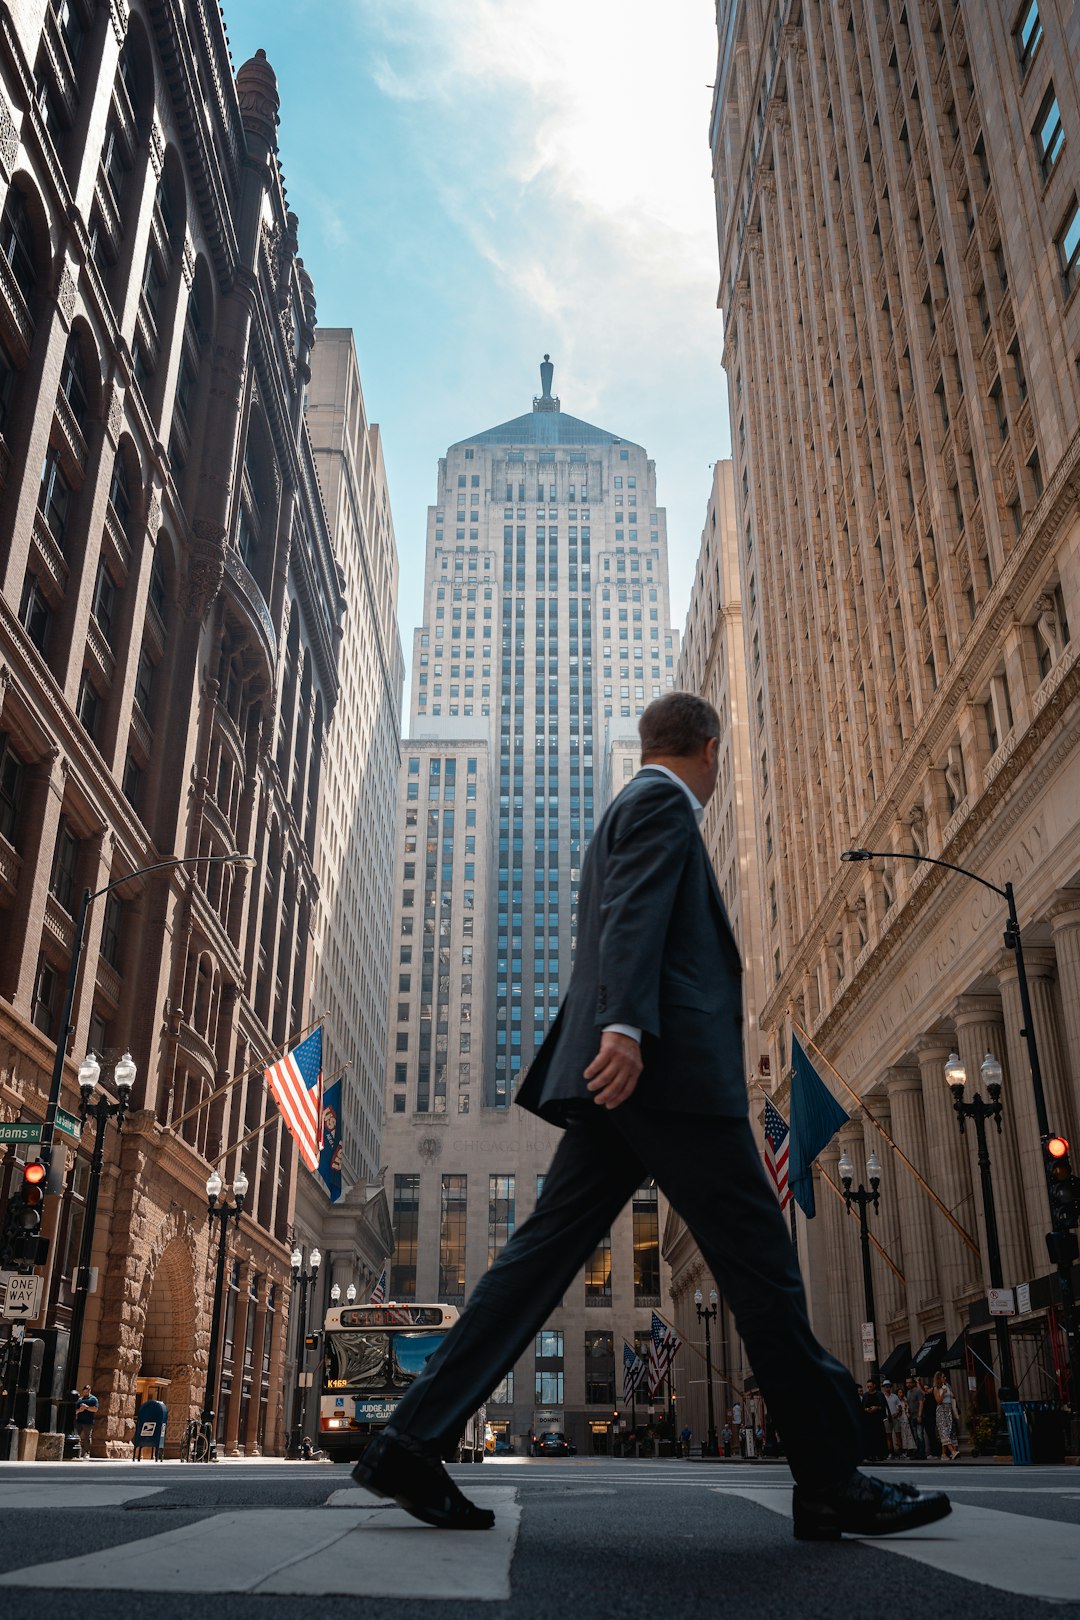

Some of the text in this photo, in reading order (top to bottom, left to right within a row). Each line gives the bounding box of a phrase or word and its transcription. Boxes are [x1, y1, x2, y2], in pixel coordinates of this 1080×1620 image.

[900, 969, 921, 1013] AND
[925, 916, 961, 983] TRUST
[970, 823, 1043, 932] COMPANY
[0, 1128, 28, 1138] dams
[453, 1140, 520, 1152] CHICAGO
[11, 1280, 34, 1289] ONE
[10, 1291, 33, 1300] WAY
